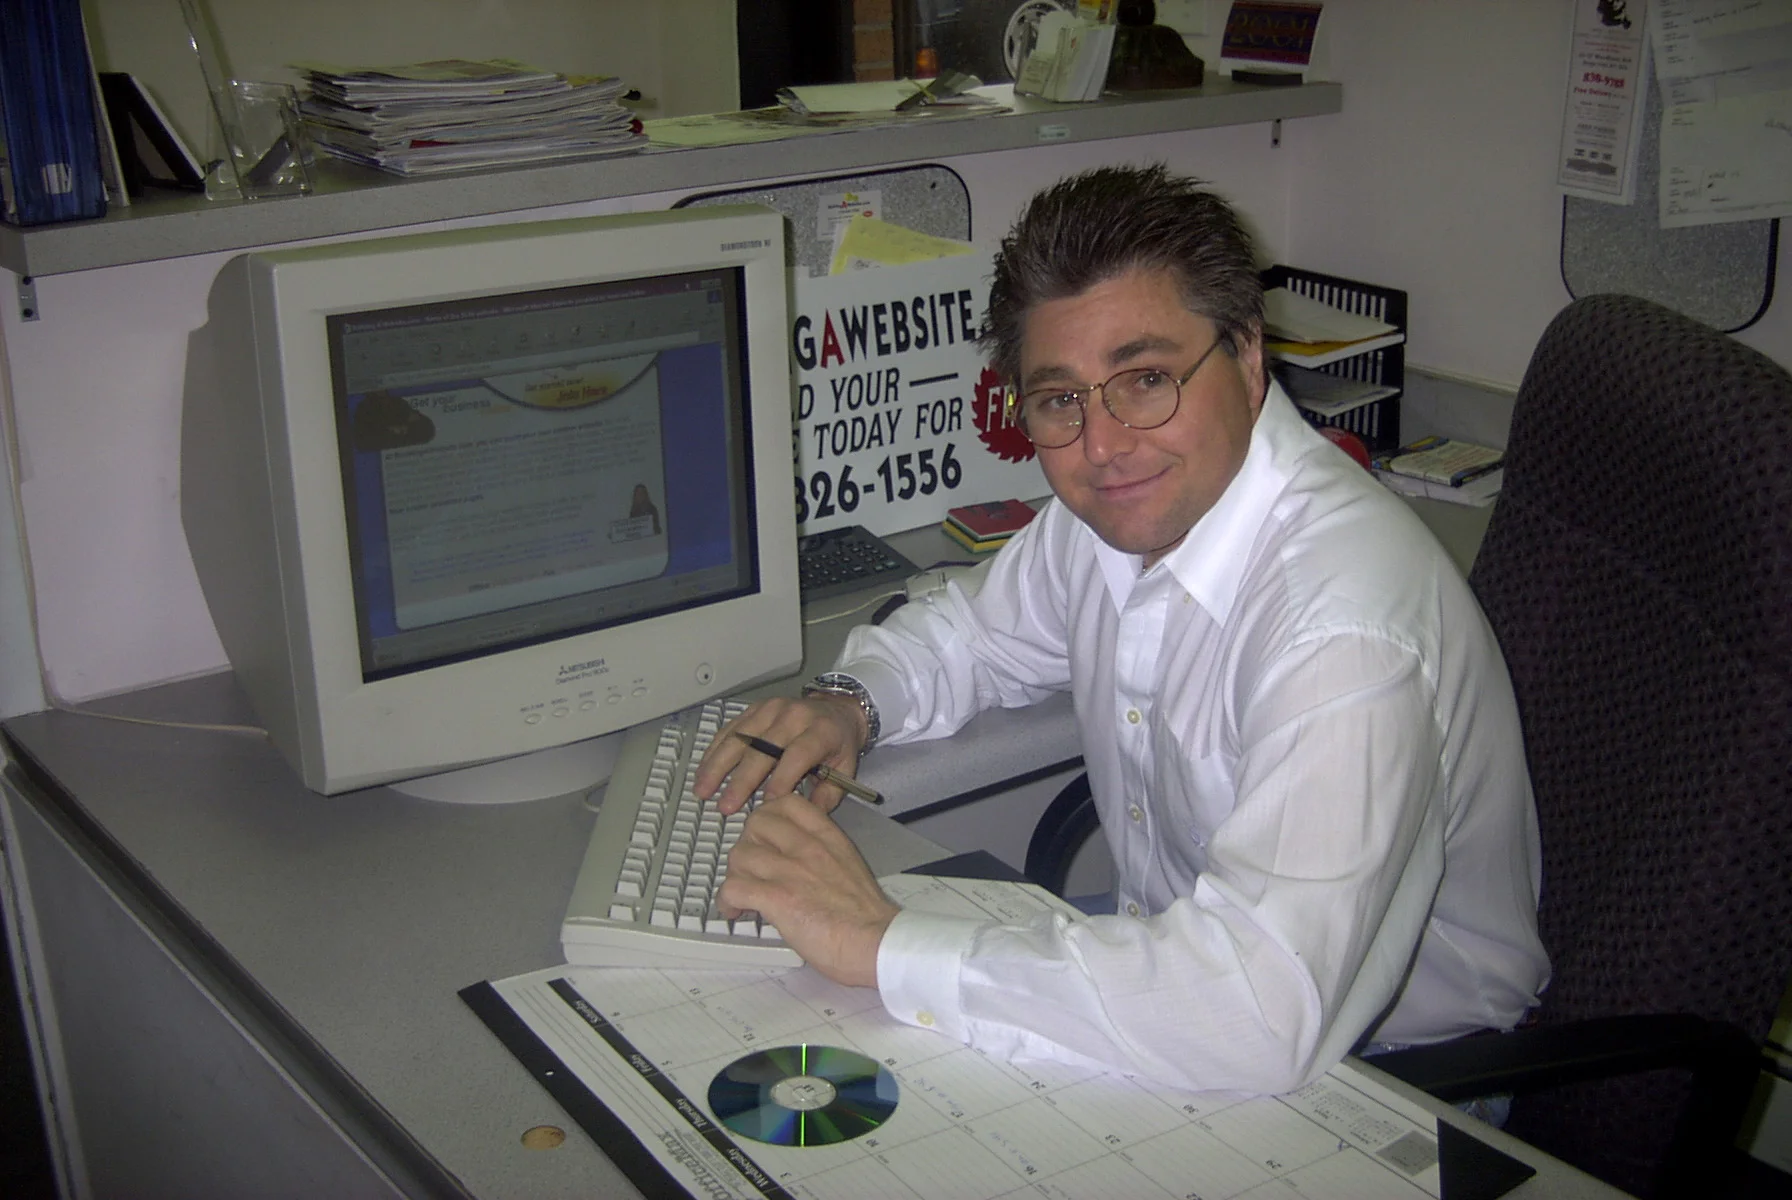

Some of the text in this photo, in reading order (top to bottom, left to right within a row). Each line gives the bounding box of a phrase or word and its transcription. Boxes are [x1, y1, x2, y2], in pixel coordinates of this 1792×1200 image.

[830, 367, 900, 414] YOUR
[813, 408, 902, 460] TODAY
[915, 397, 963, 440] FOR
[575, 1000, 601, 1024] Saturday
[631, 1053, 654, 1074] Friday
[676, 1098, 708, 1127] Thursday
[728, 1148, 770, 1188] Wednesday
